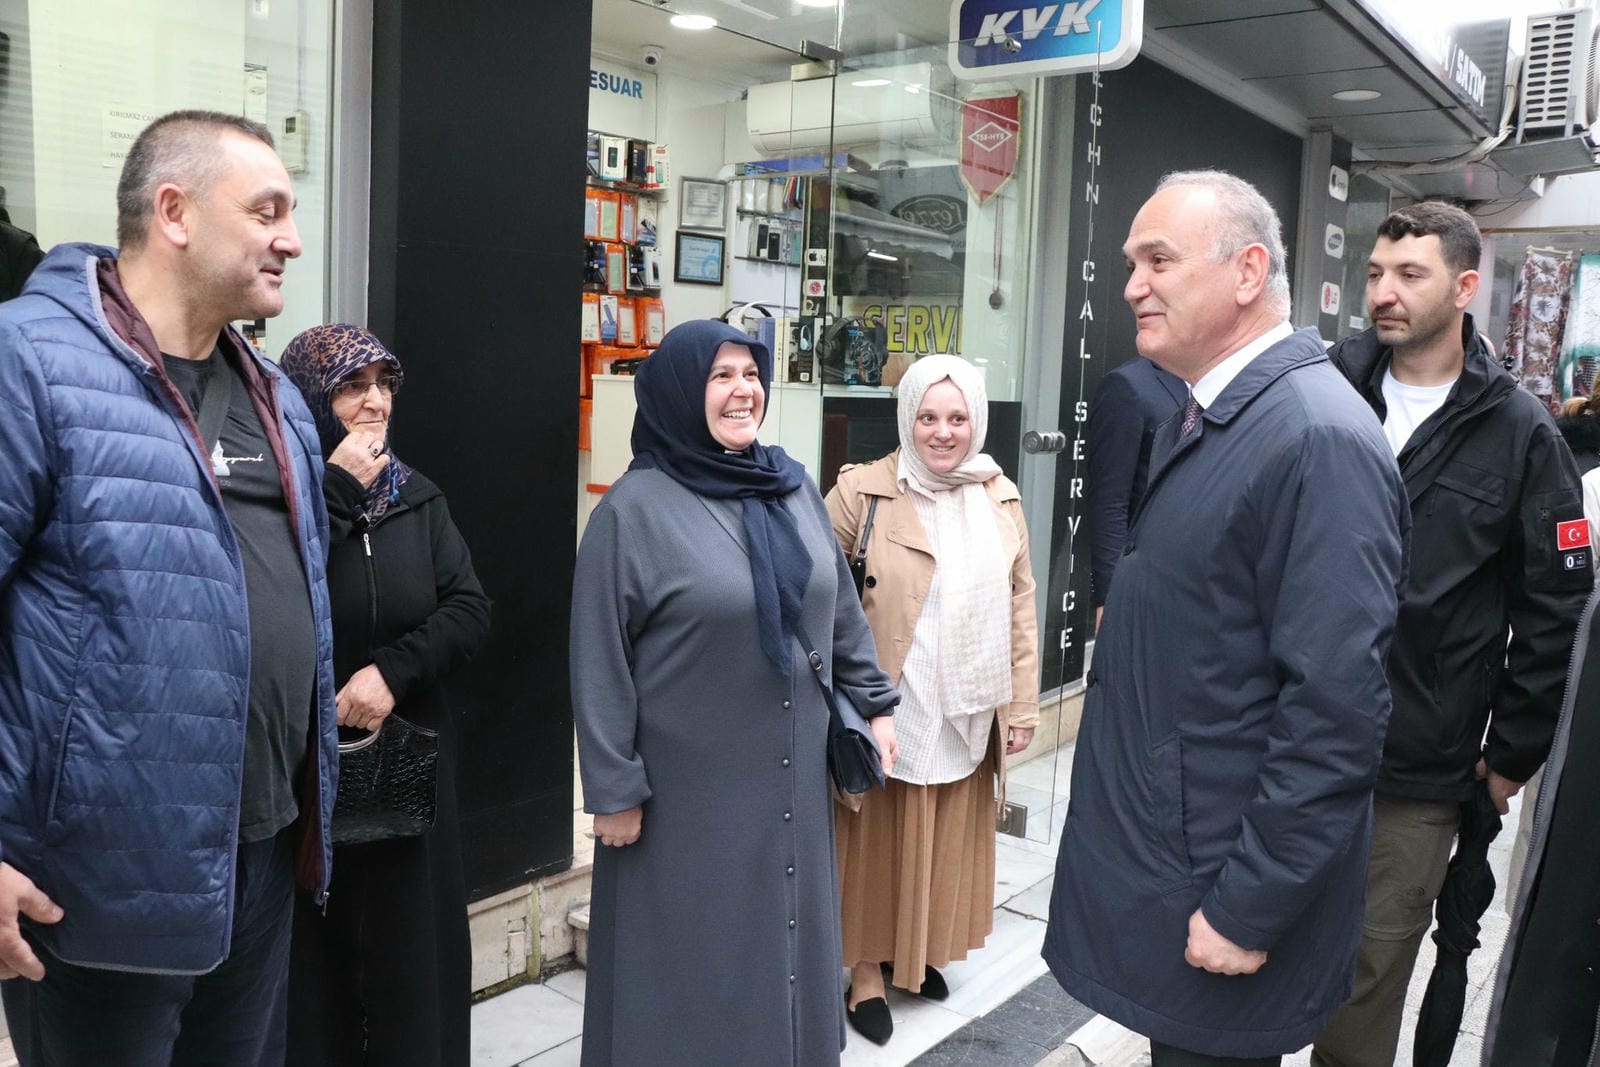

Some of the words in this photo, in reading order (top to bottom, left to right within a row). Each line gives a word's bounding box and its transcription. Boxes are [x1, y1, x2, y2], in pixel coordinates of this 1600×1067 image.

[974, 0, 1098, 47] KVK
[587, 70, 642, 100] ESUAR
[1060, 401, 1088, 650] SERVICE
